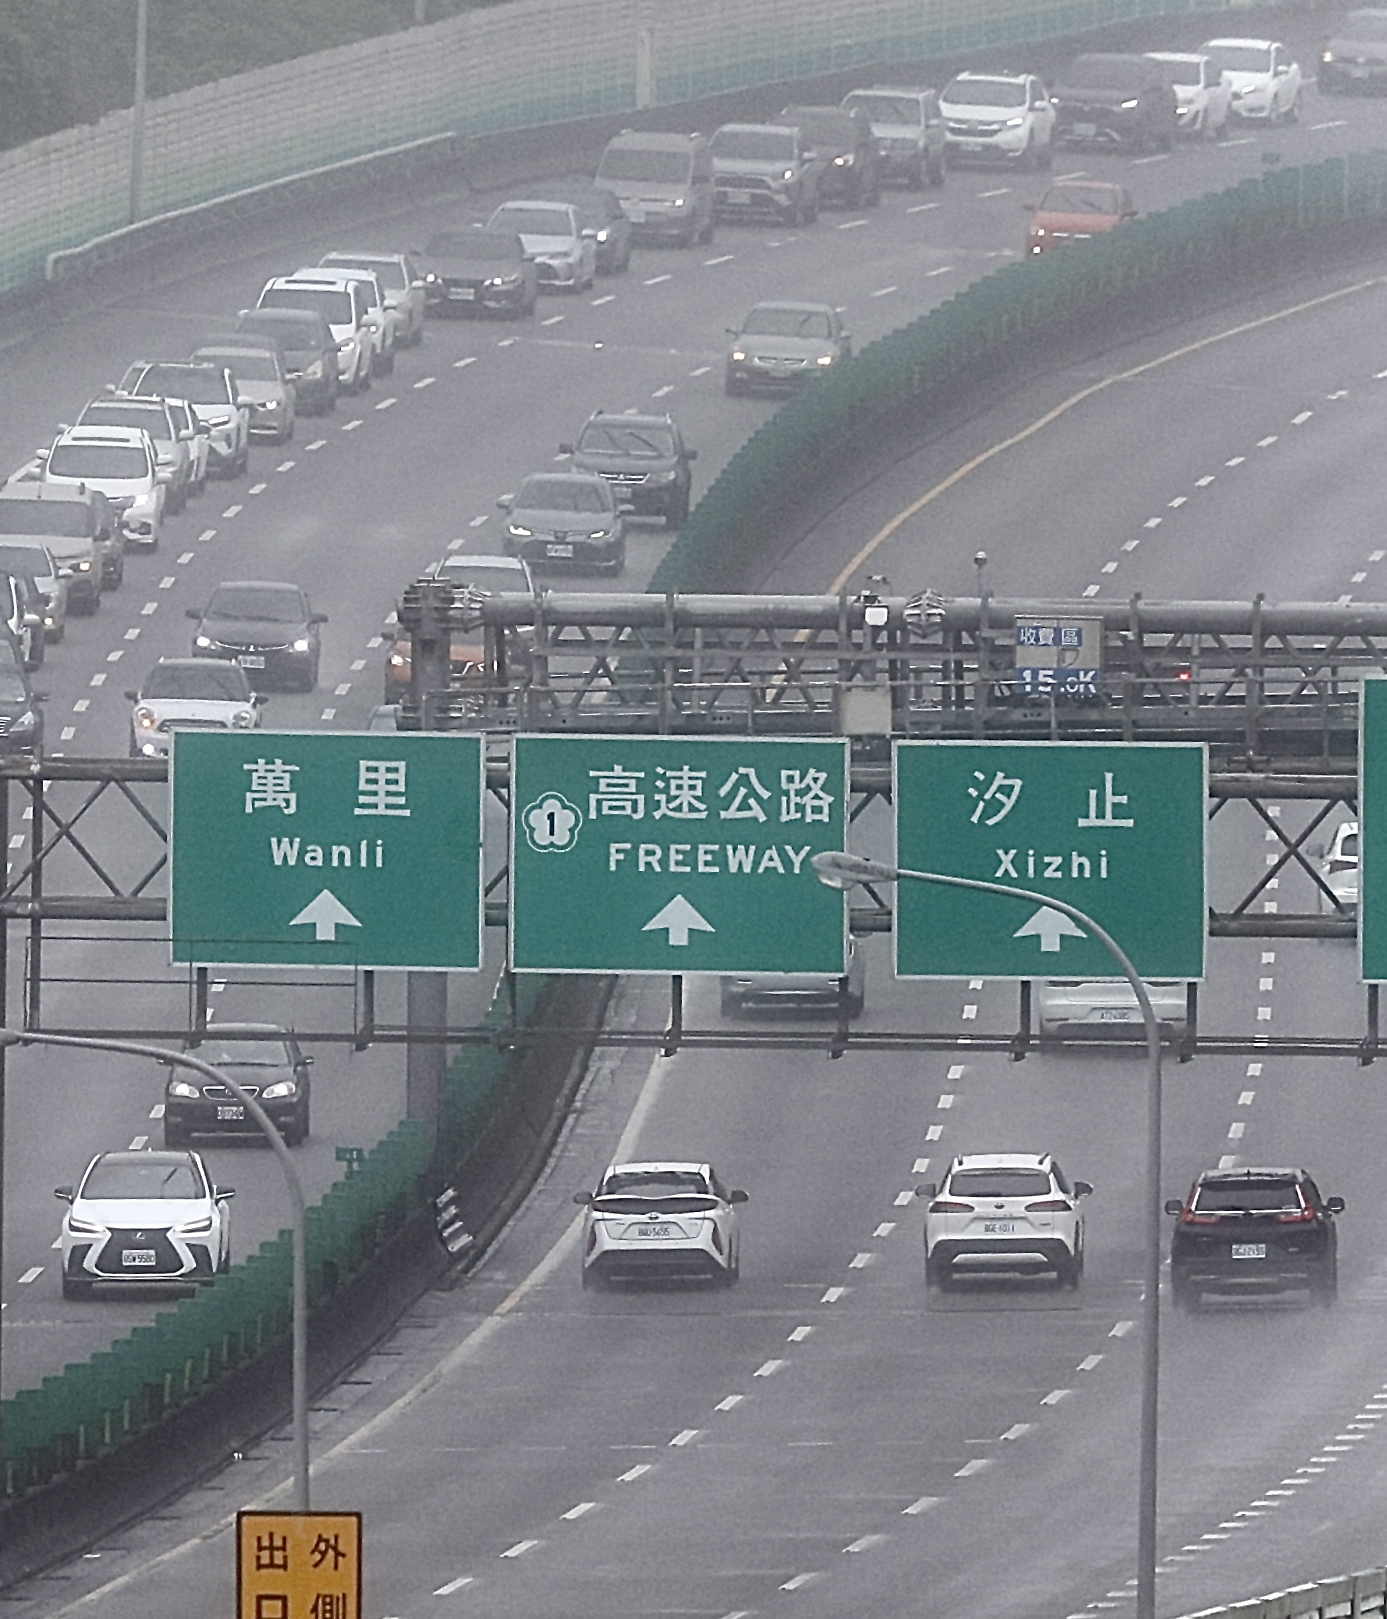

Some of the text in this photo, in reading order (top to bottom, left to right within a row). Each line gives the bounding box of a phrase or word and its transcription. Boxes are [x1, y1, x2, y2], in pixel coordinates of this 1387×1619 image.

[243, 758, 411, 817] 萬里
[588, 764, 835, 823] 高速公路
[967, 770, 1134, 827] 汐止
[546, 811, 555, 837] 1
[270, 837, 384, 867] Wanli
[609, 842, 812, 874] FREEWAY
[994, 849, 1108, 878] Xizhi
